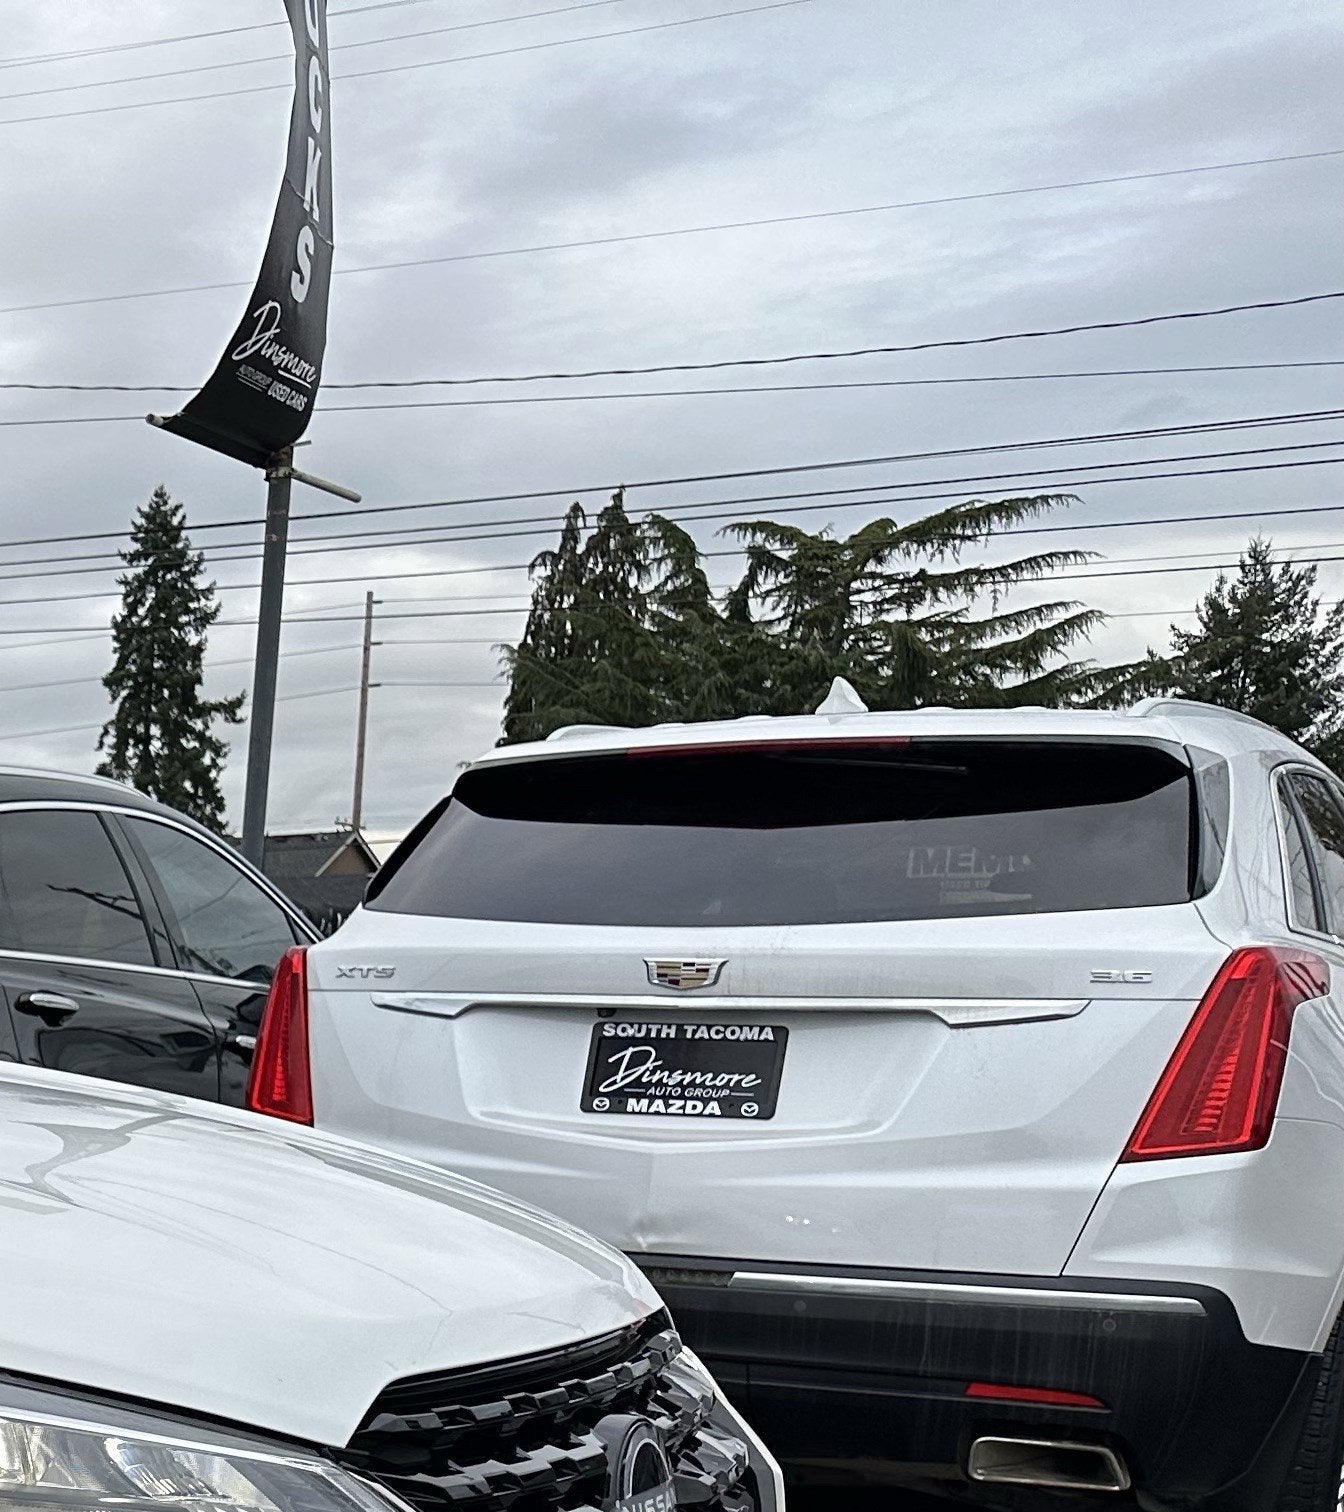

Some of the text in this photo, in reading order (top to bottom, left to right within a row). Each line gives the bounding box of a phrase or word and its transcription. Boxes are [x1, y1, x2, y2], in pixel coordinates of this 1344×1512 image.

[232, 300, 317, 383] Dinsmore
[602, 1023, 775, 1041] SOUTH TACOMA
[598, 1046, 762, 1093] Dinsmore
[646, 1086, 731, 1098] AUTO GROUP
[626, 1098, 722, 1116] MAZDA
